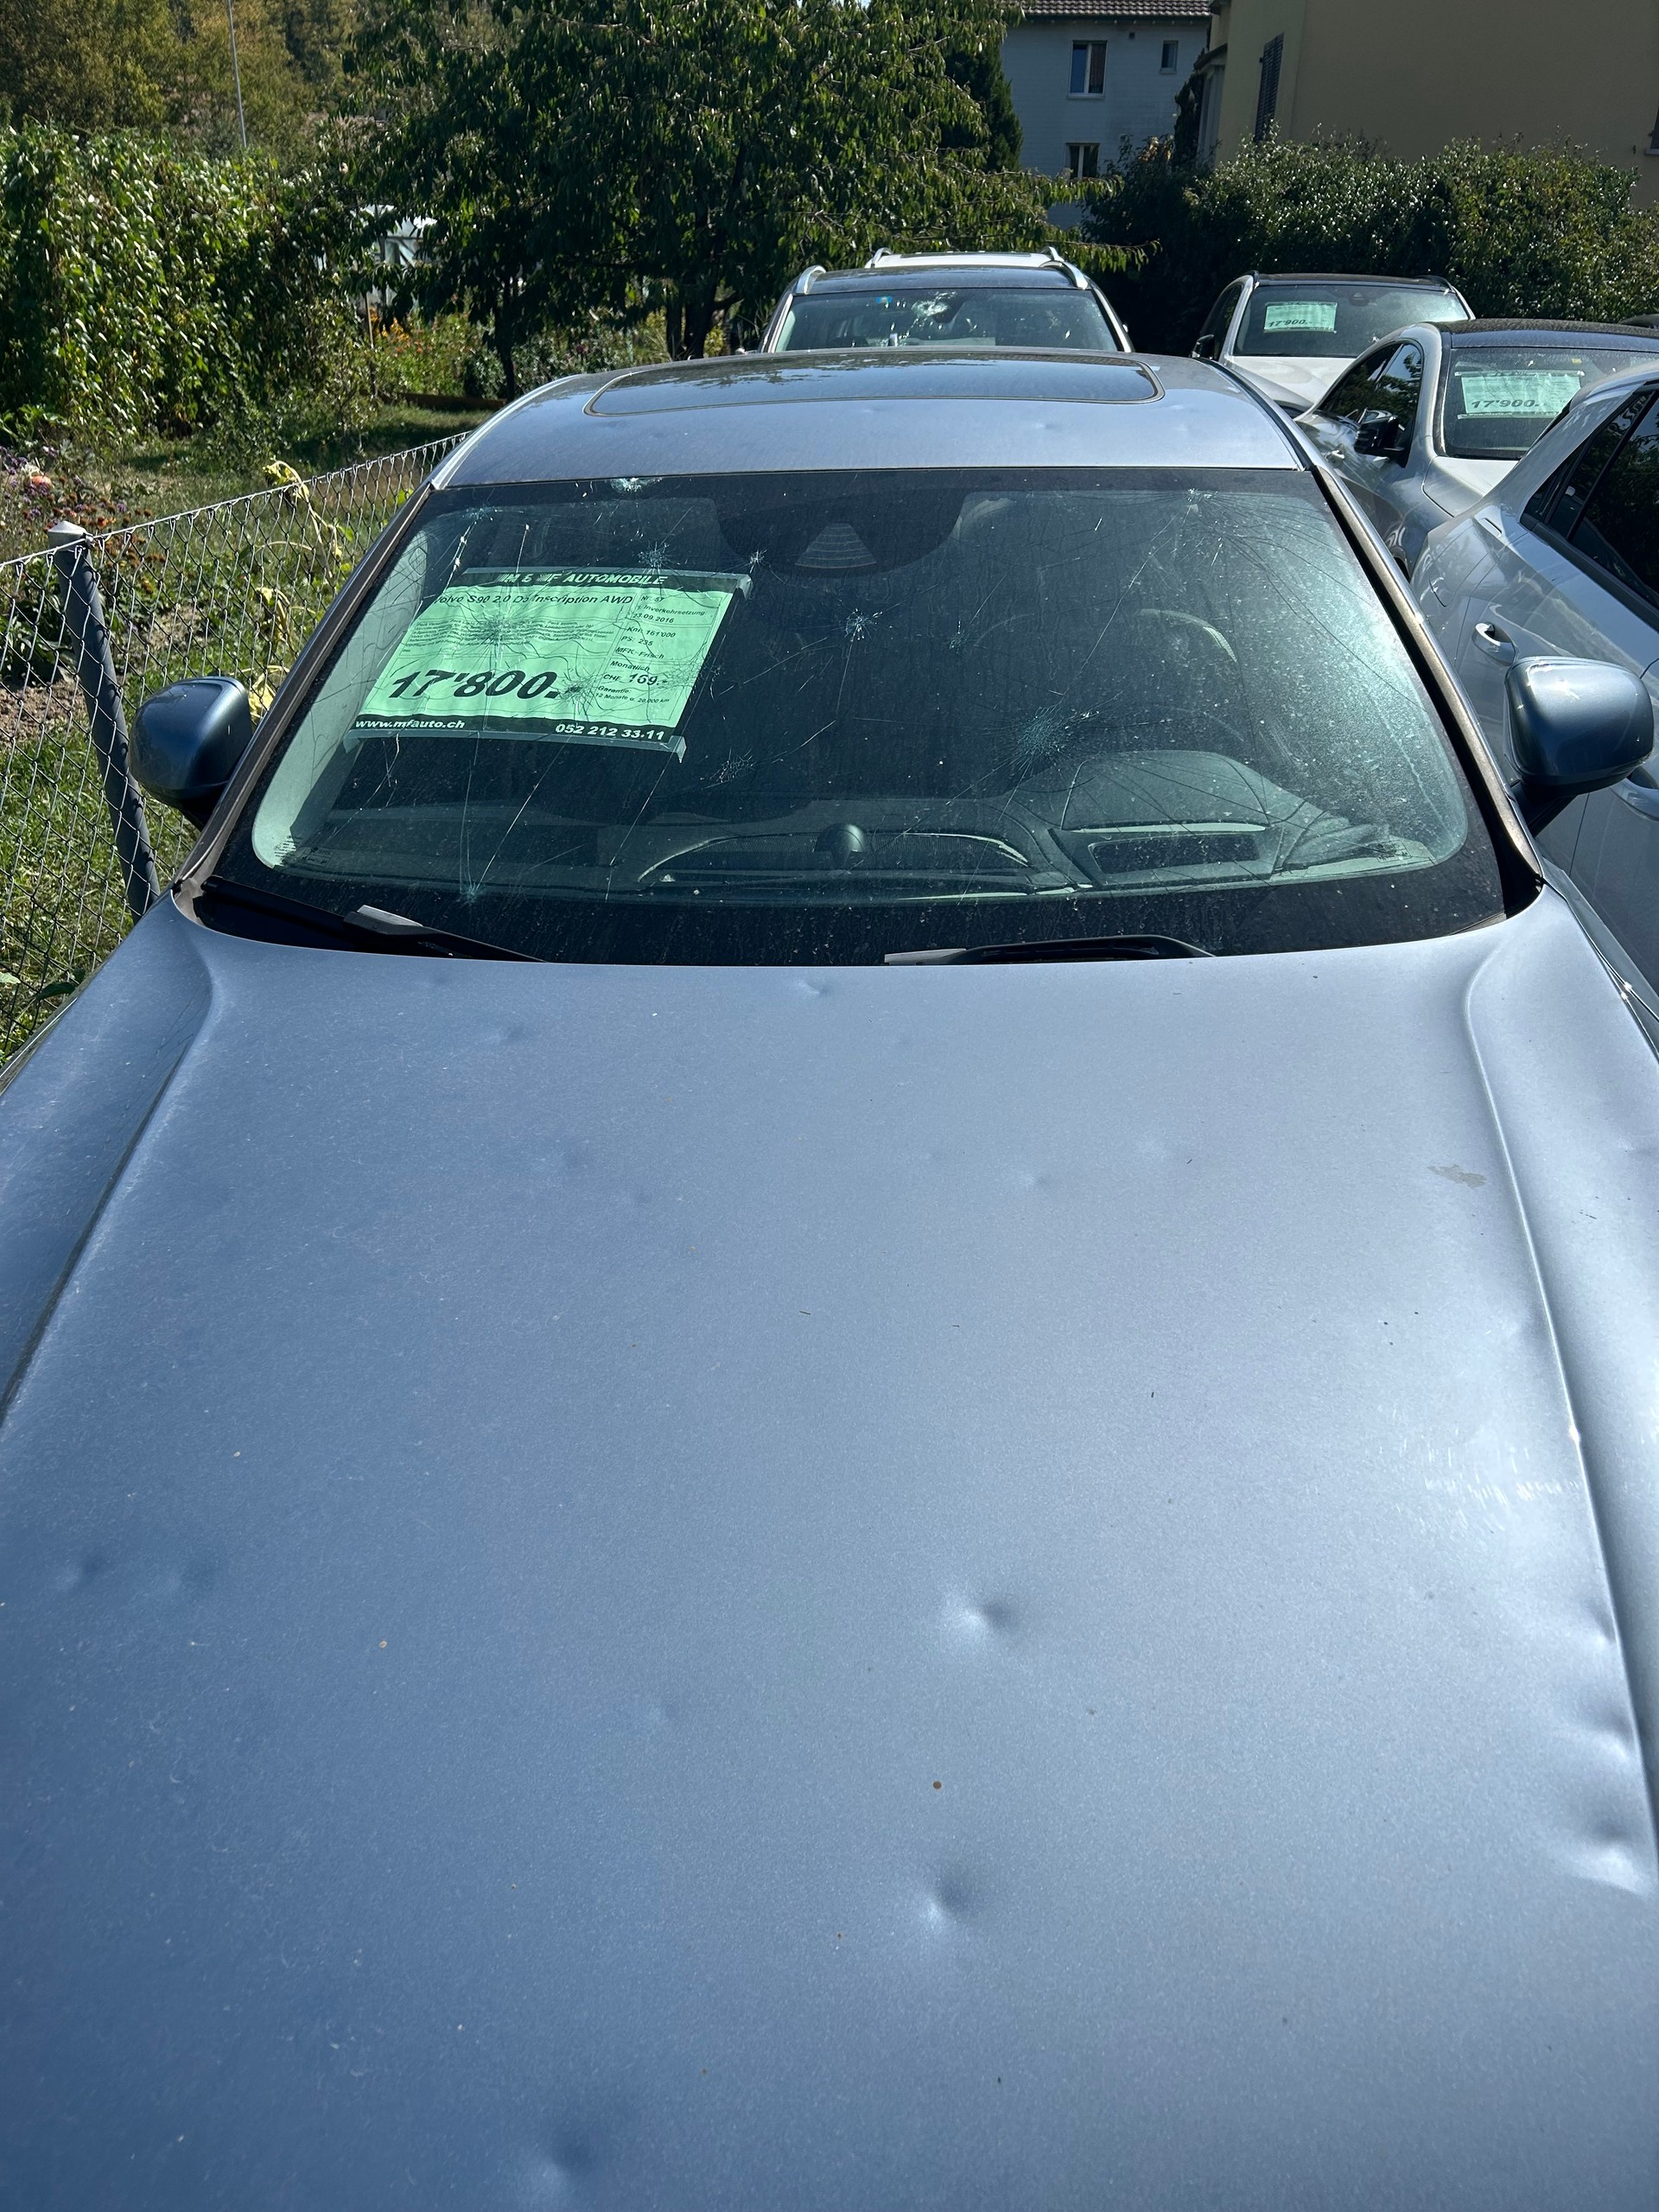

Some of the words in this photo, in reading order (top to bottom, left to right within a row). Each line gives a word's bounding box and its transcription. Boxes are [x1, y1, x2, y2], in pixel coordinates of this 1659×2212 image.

[563, 573, 669, 585] AUTOMOBILE
[601, 595, 633, 604] AWD
[355, 719, 466, 728] www.mfauto.ch
[555, 723, 584, 734] 052
[588, 726, 619, 736] 212
